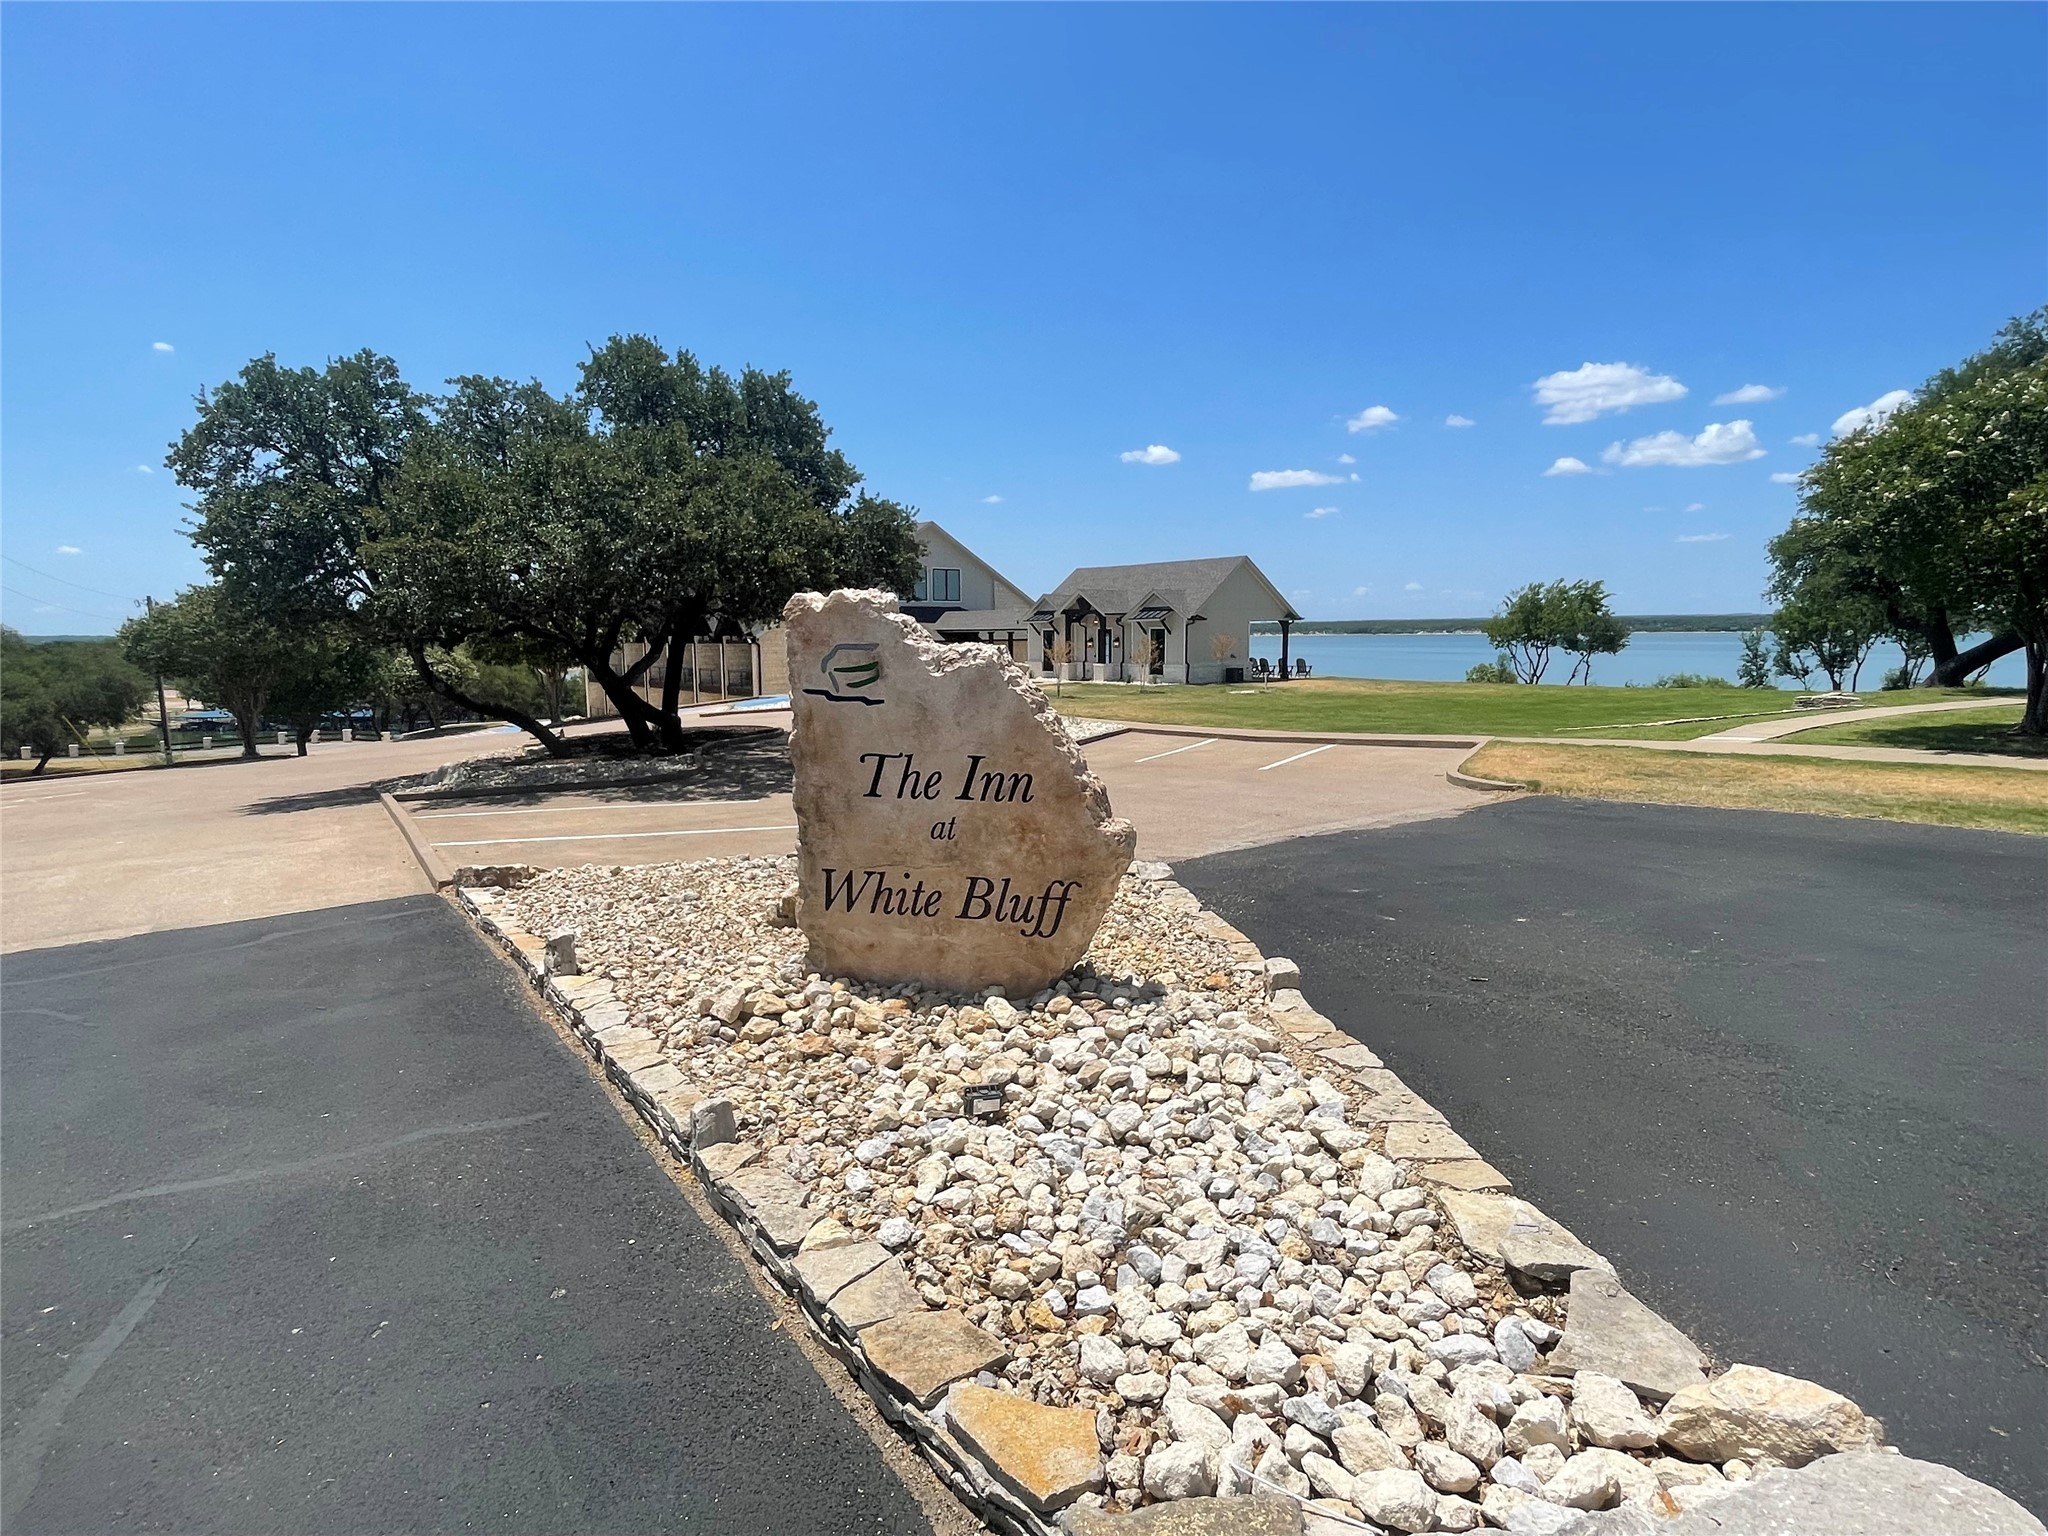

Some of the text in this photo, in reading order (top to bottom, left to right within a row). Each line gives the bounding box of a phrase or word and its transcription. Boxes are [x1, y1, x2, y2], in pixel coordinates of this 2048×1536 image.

[859, 752, 1035, 803] The Inn
[930, 816, 957, 841] at
[821, 868, 1082, 939] White Bluff
